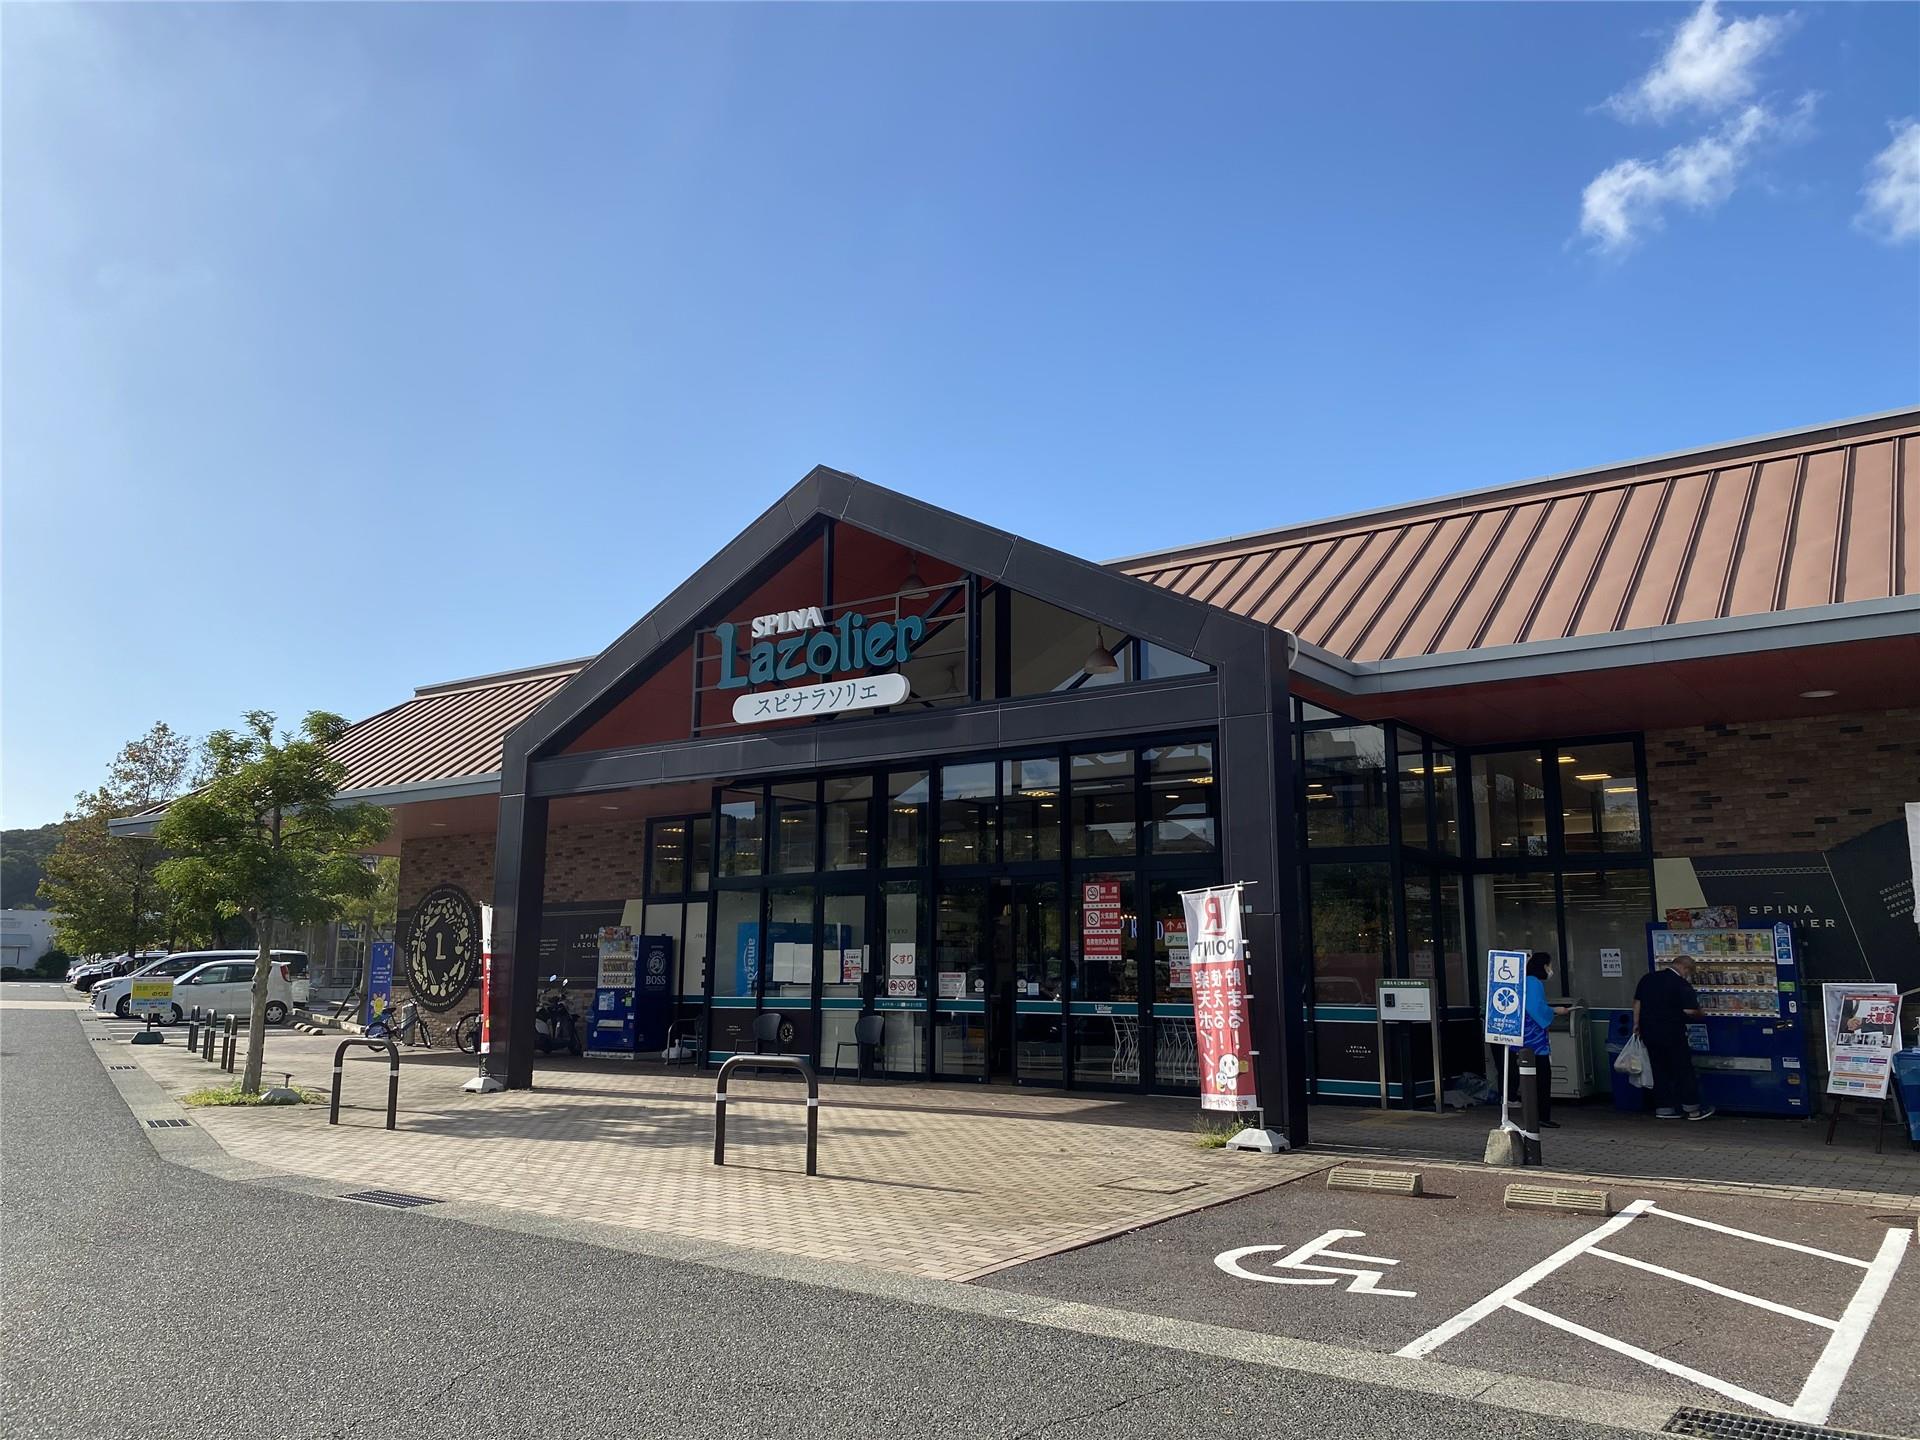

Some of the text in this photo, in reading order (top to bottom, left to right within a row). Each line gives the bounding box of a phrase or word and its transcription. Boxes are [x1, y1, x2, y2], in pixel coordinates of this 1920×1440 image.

[752, 606, 825, 638] SPINA
[715, 611, 926, 689] Lazolier
[754, 682, 878, 716] スピナラソリエ
[1749, 905, 1814, 914] SPINA
[892, 954, 914, 965] くすり
[645, 975, 666, 985] BOSS
